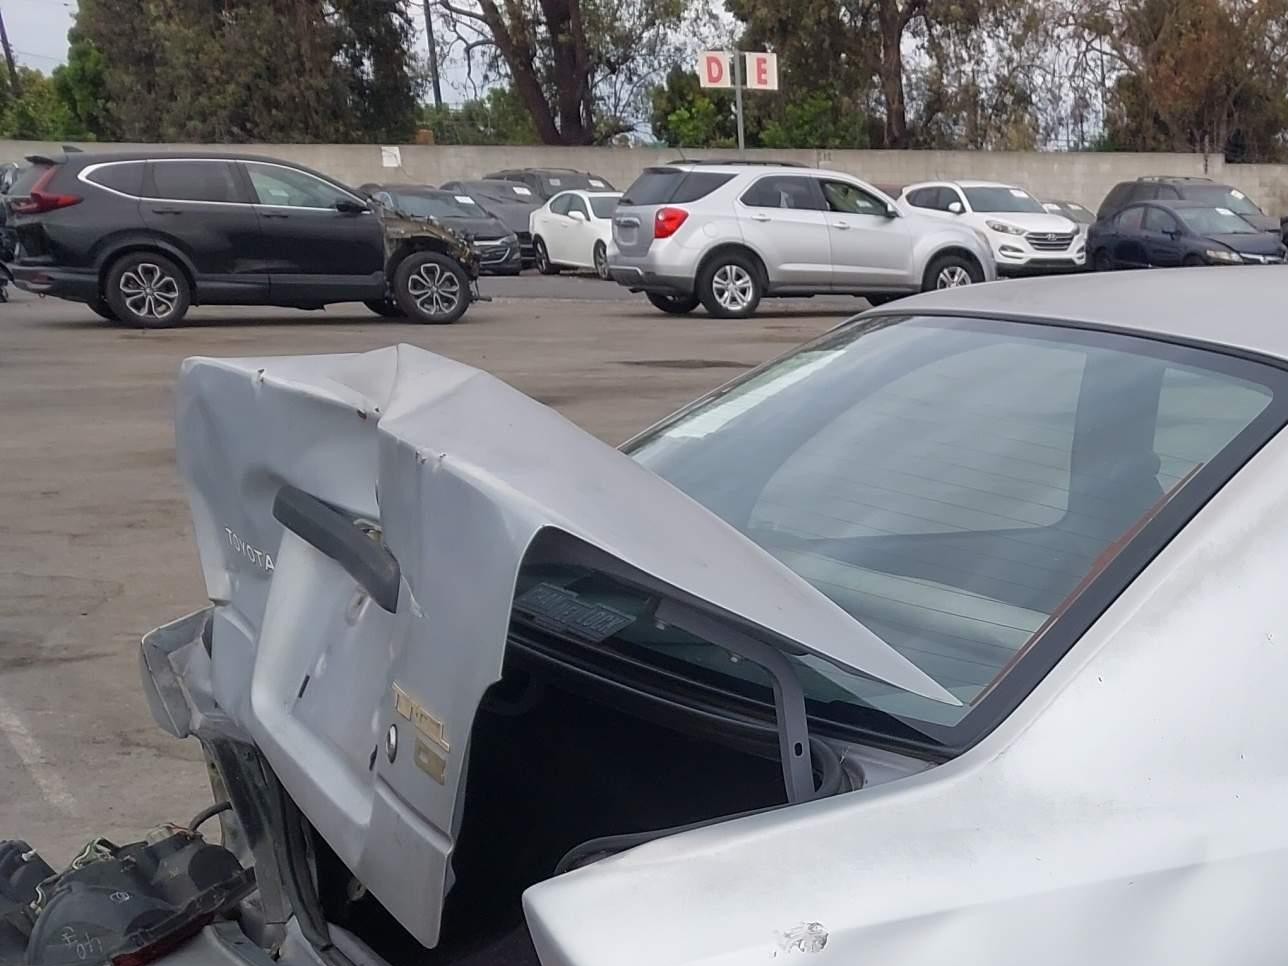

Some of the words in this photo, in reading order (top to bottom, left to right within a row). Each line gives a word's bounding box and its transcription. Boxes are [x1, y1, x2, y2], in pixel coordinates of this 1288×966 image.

[706, 56, 723, 83] D
[756, 57, 768, 84] E
[225, 527, 275, 571] TOYOTA
